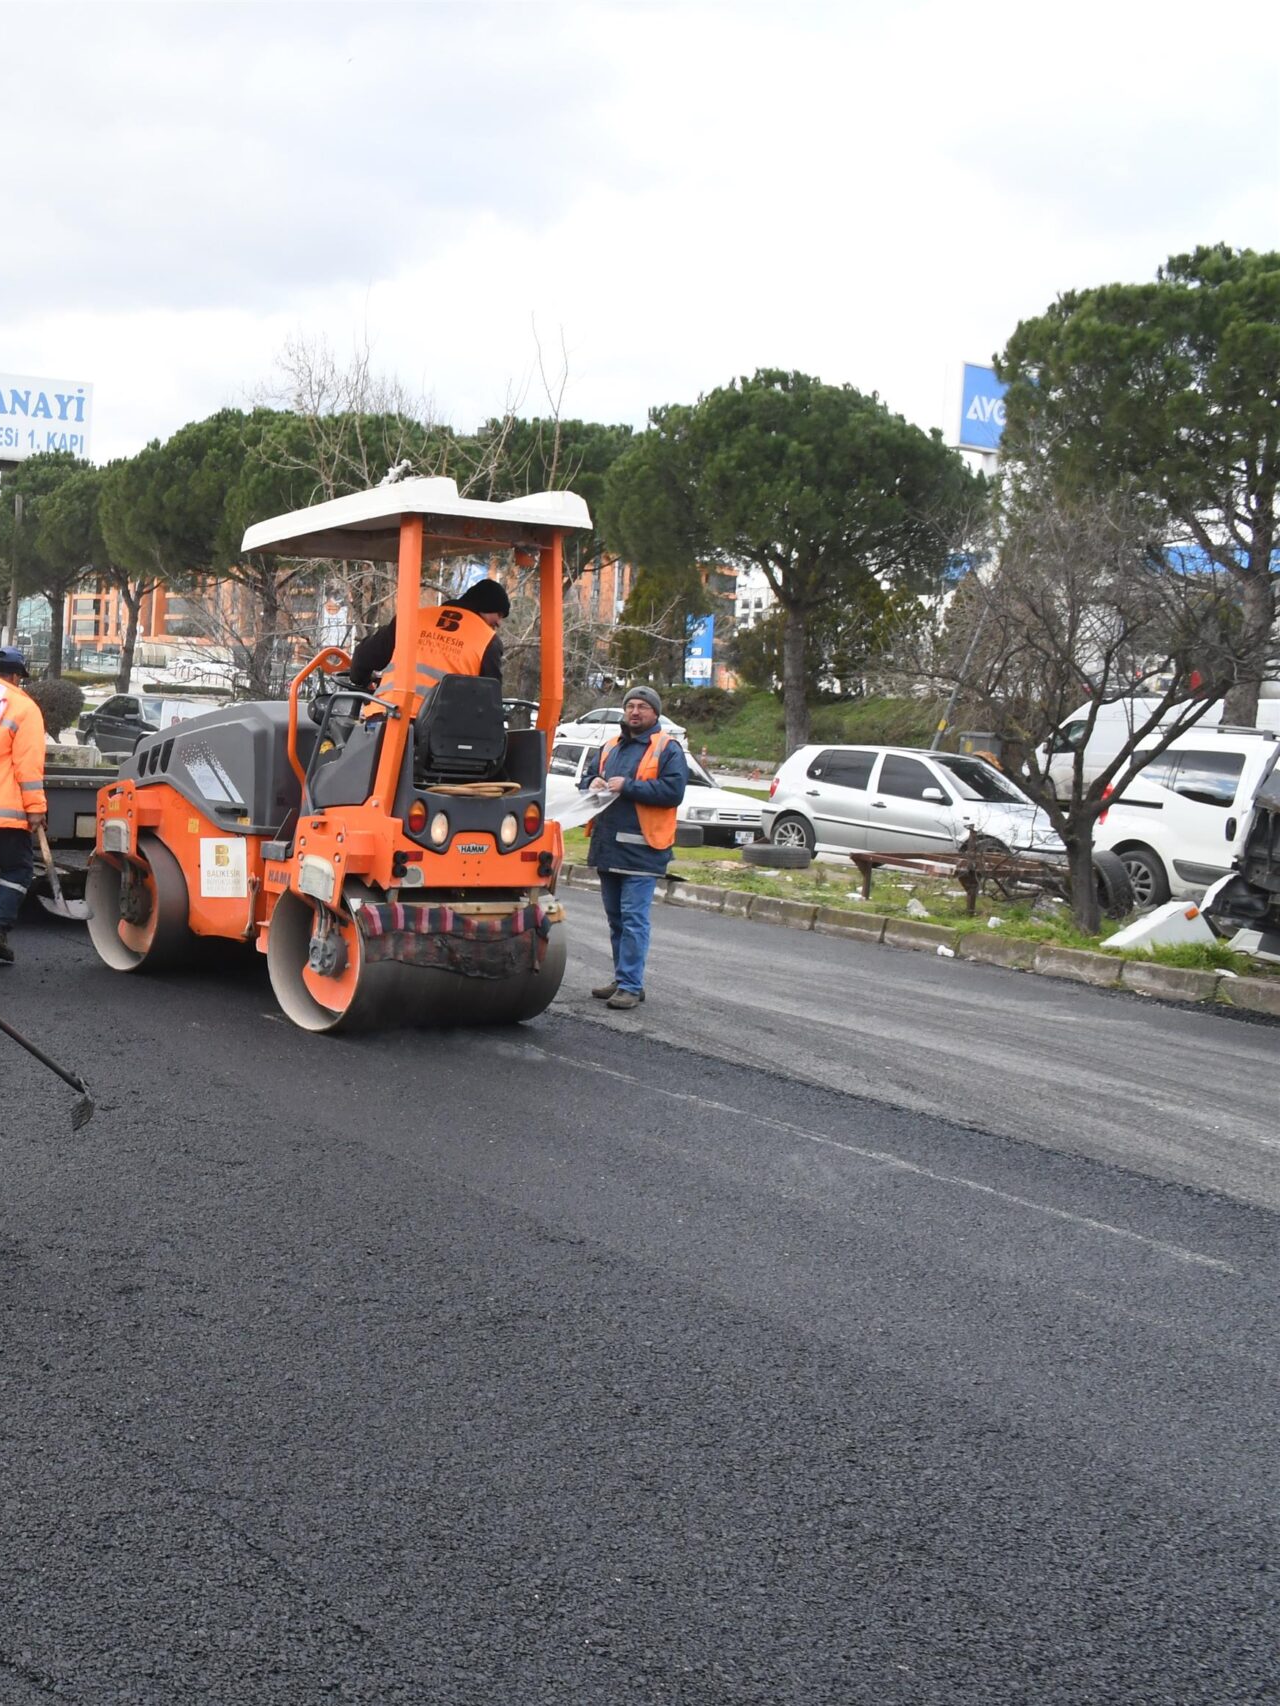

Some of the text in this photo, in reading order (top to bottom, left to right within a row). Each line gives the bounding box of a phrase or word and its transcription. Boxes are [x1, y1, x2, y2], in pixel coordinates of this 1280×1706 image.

[966, 394, 1007, 426] AYG
[28, 429, 40, 449] 1.
[46, 431, 84, 454] KAPI
[461, 844, 484, 853] HAMM
